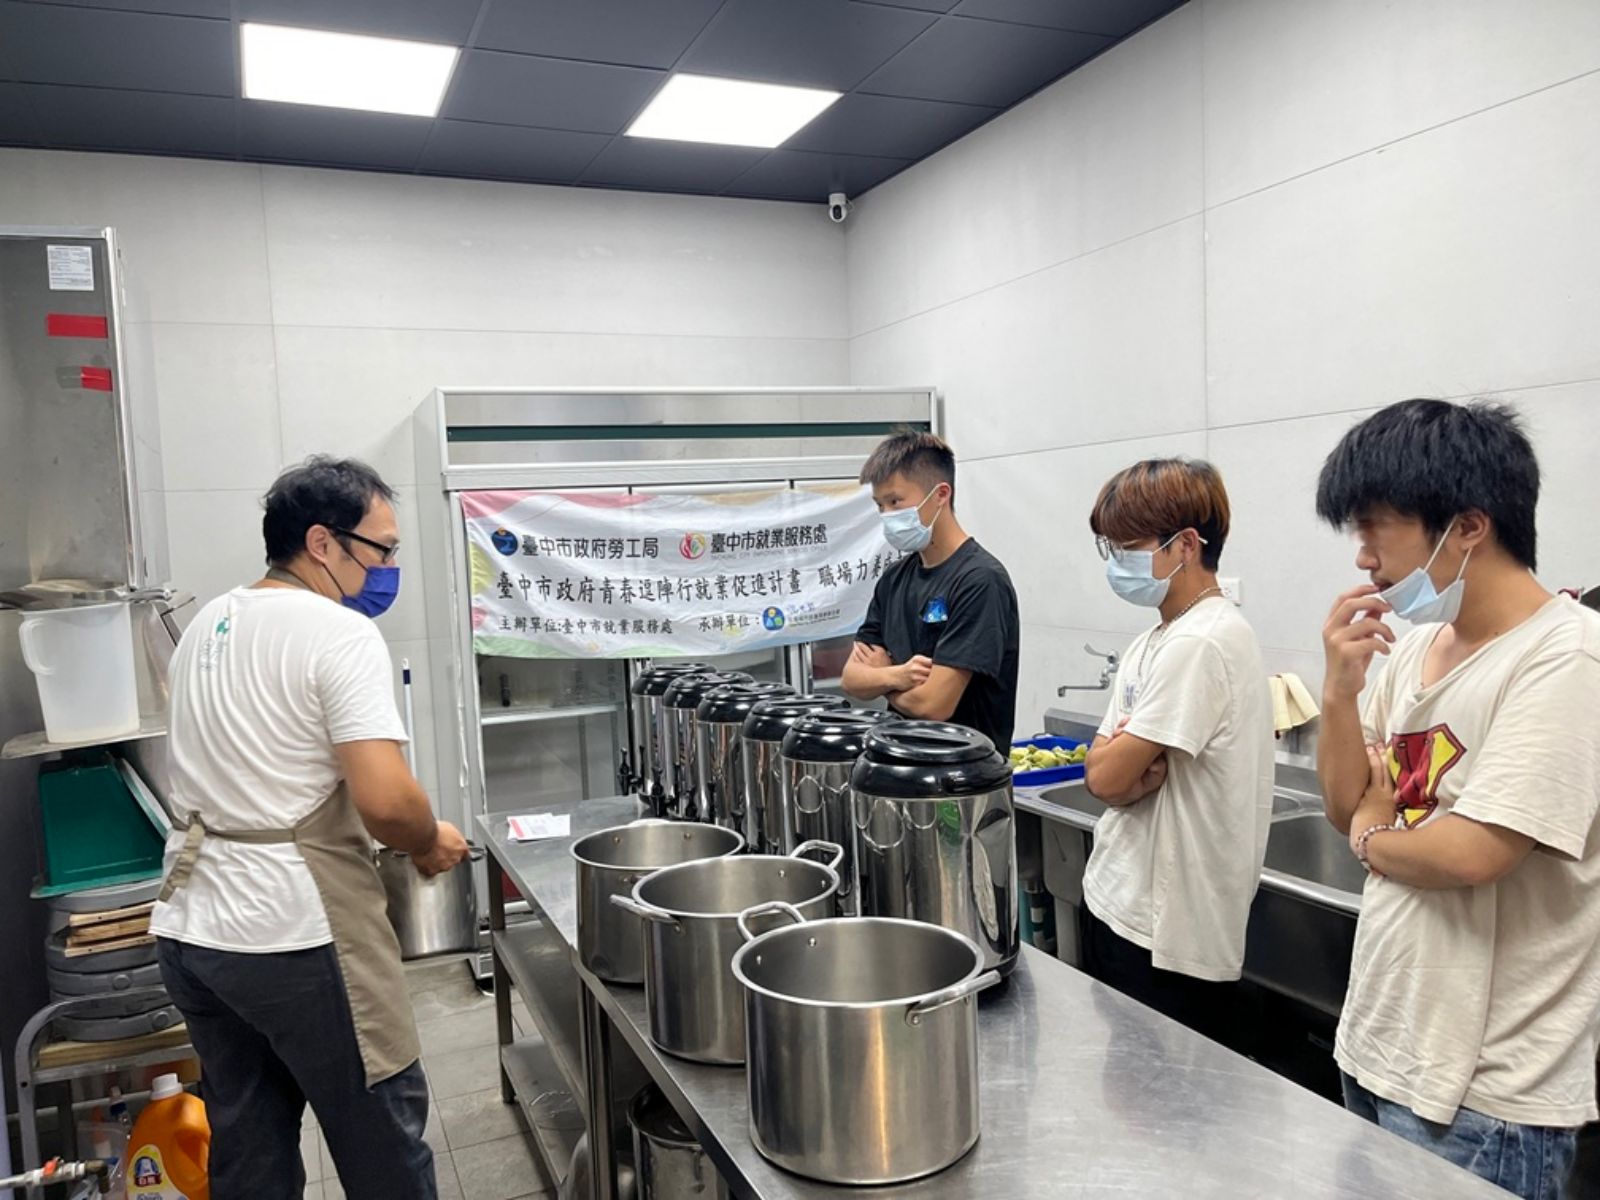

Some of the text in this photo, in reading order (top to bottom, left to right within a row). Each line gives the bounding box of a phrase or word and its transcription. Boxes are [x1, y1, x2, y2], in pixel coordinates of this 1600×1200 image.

[521, 534, 659, 560] 臺中市政府勞工局
[710, 523, 828, 554] 臺中市就業服務處
